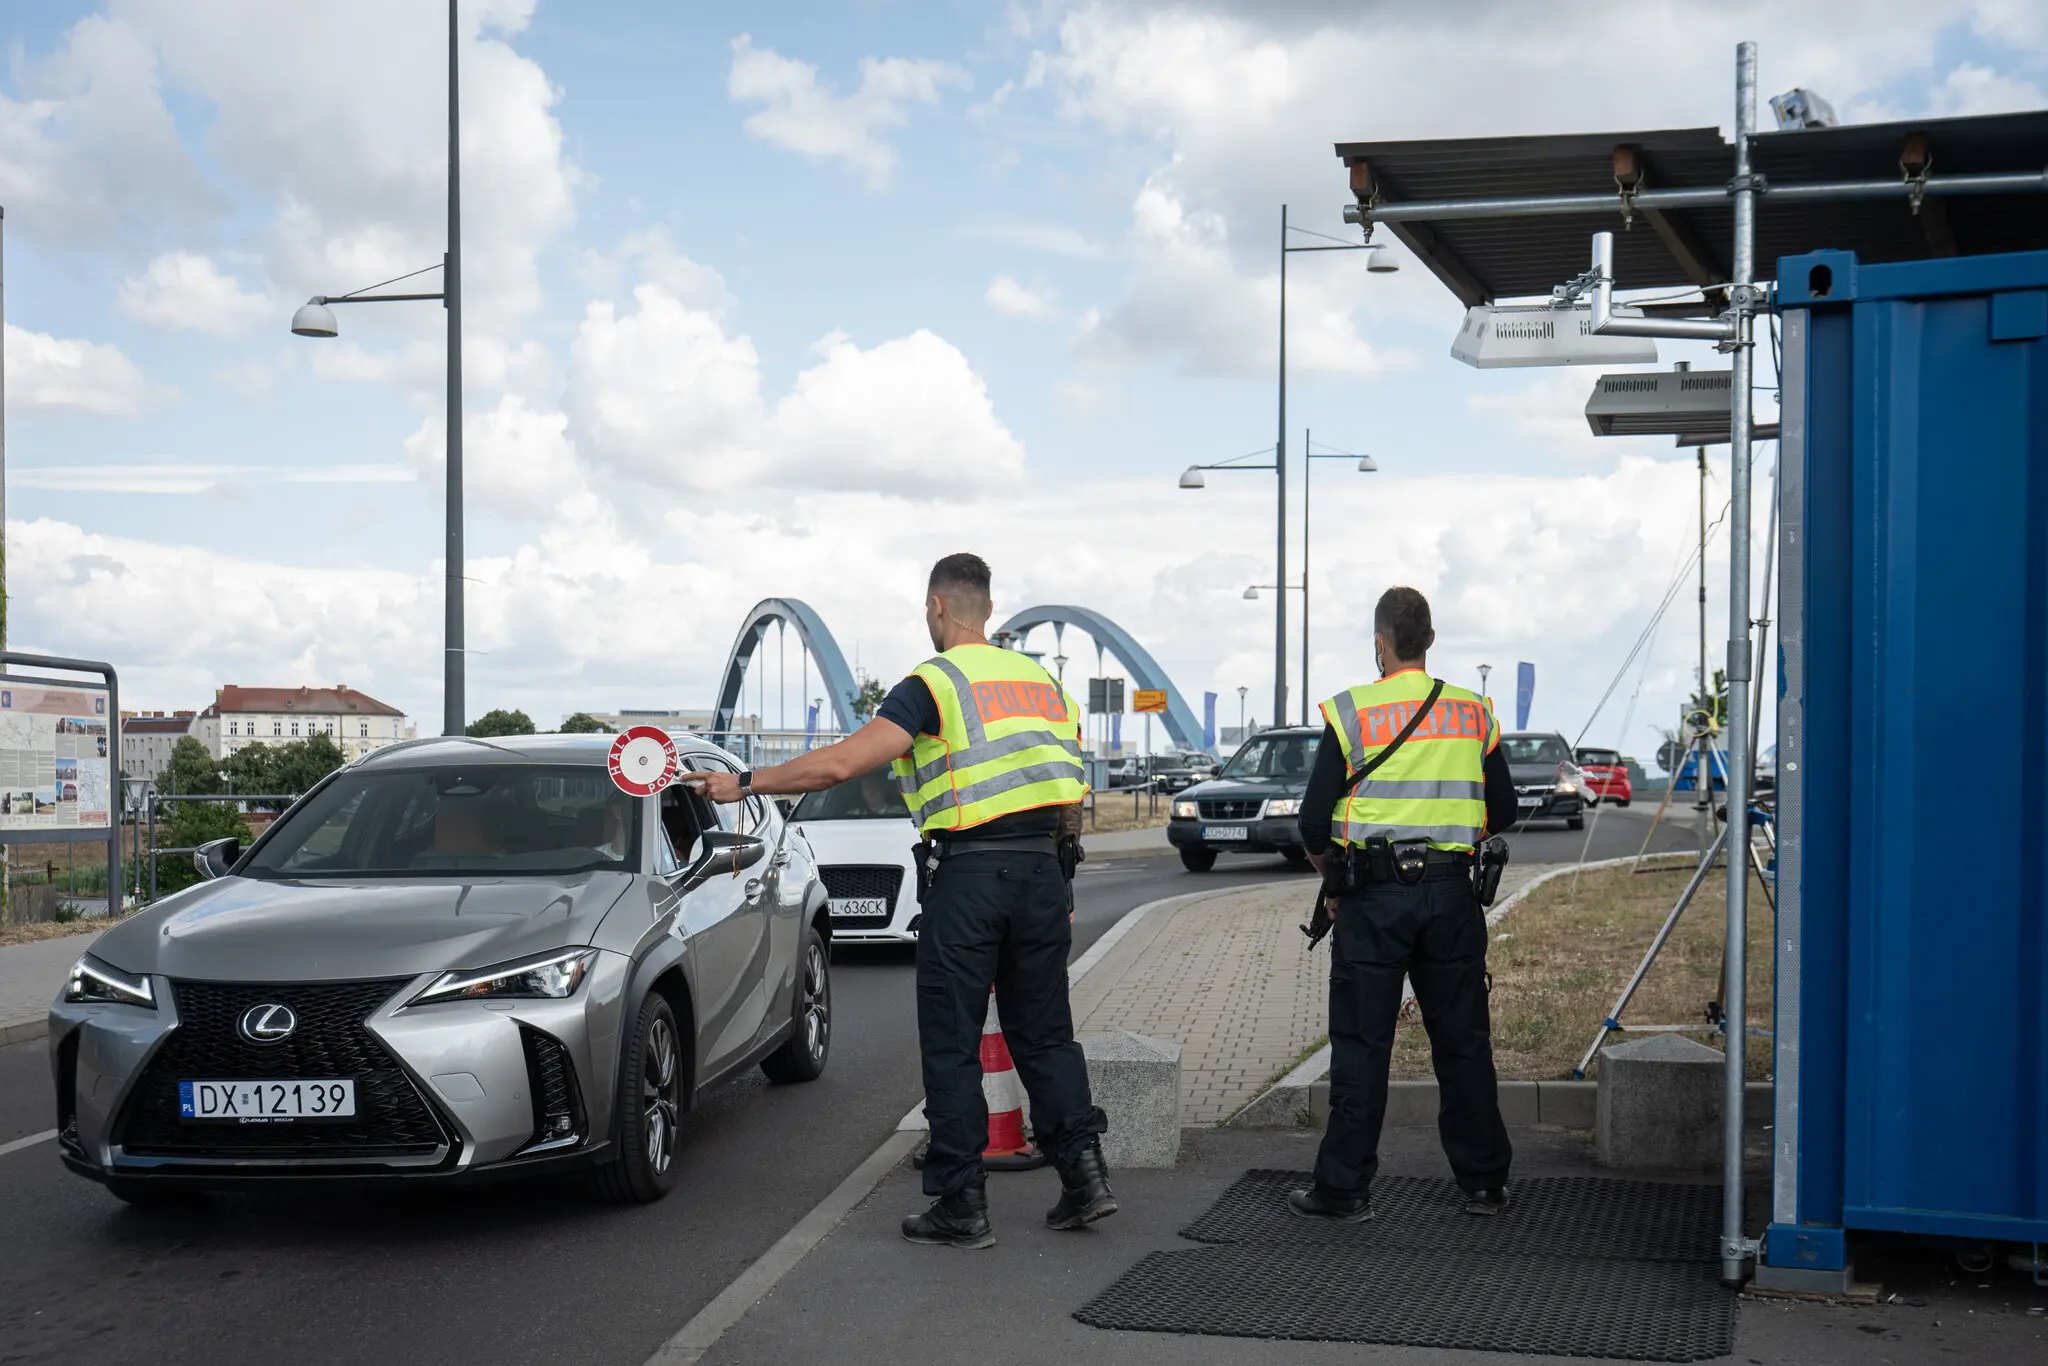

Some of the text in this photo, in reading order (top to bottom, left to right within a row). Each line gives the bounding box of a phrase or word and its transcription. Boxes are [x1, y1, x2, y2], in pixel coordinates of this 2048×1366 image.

[1367, 701, 1481, 742] POLIZEI
[610, 731, 632, 776] HALT
[648, 740, 677, 794] POLIZEI
[844, 900, 884, 914] 636CK
[182, 1104, 193, 1112] PL
[200, 1084, 346, 1114] DX 12139
